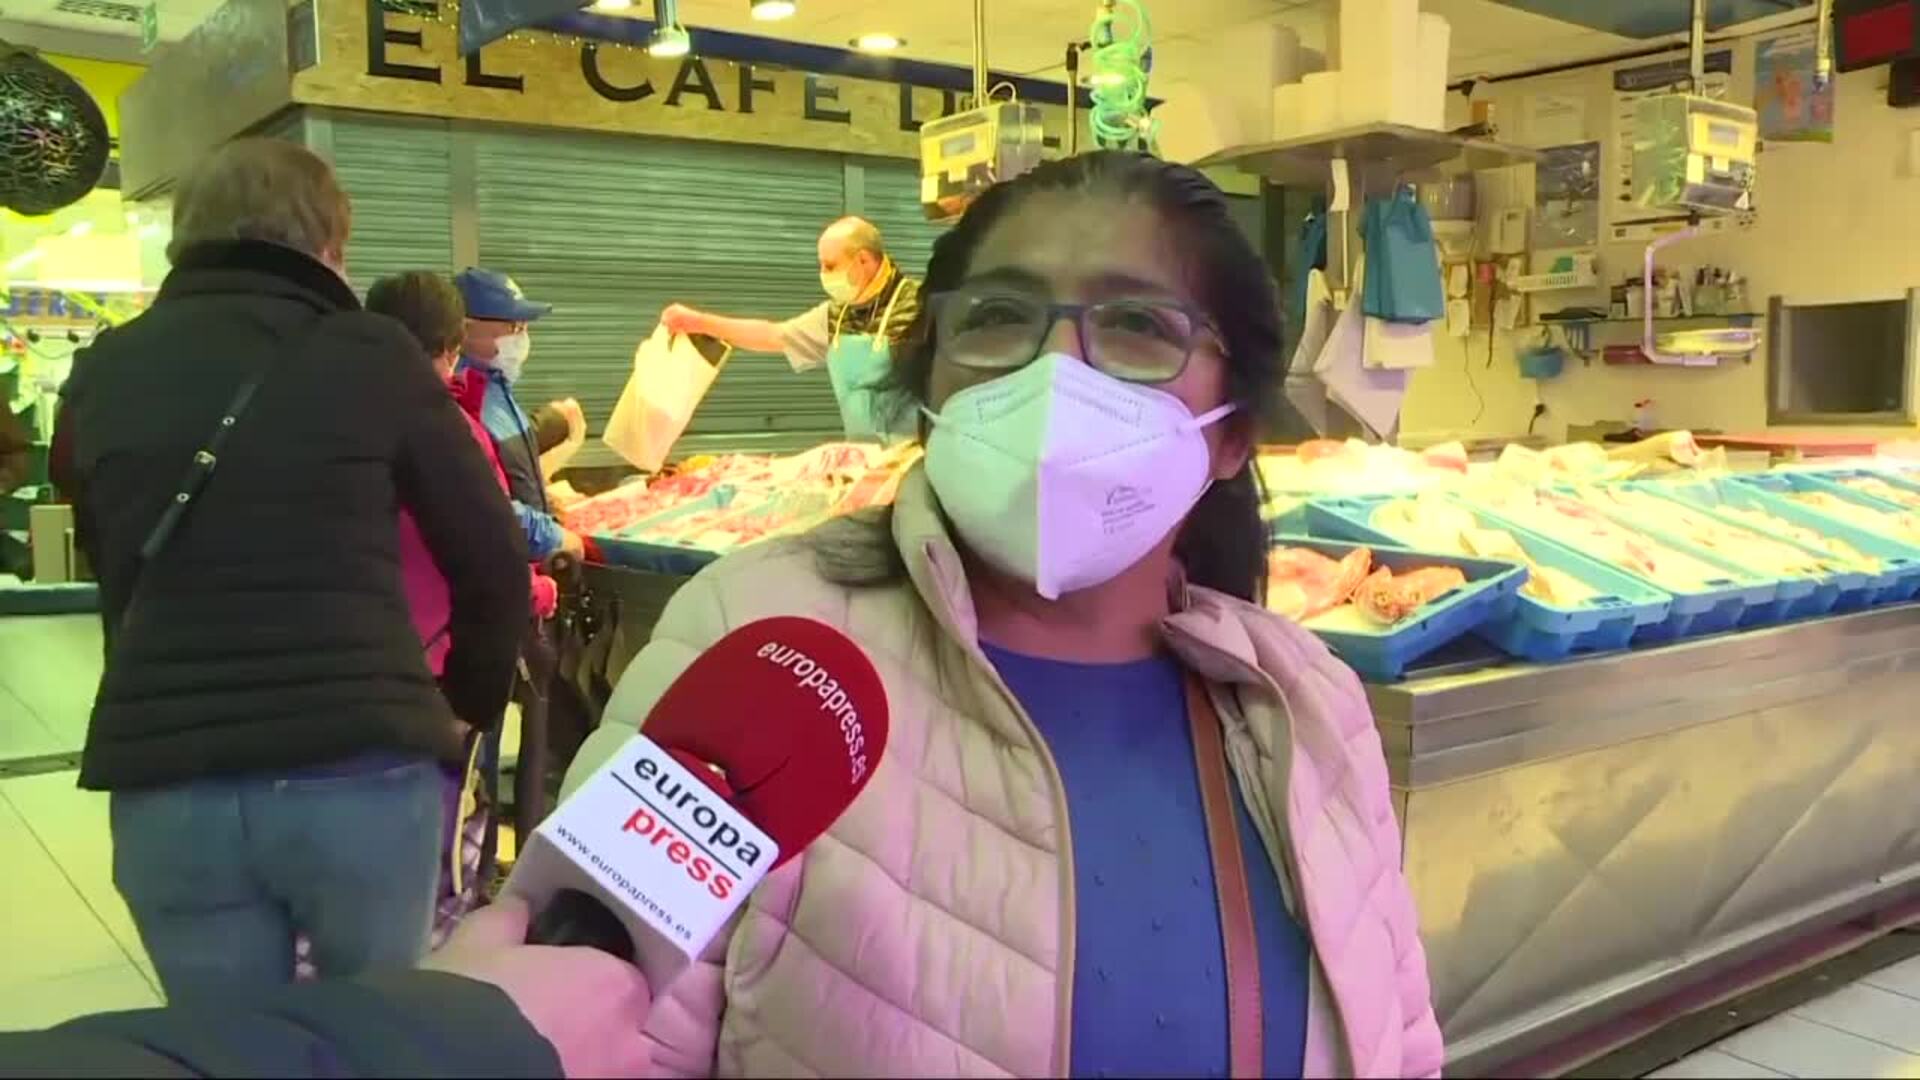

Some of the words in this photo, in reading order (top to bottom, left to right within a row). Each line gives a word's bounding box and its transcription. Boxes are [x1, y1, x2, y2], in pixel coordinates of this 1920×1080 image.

[366, 0, 525, 94] EL
[756, 641, 867, 785] europapress.es
[621, 807, 733, 901] press
[633, 757, 761, 867] europa
[556, 824, 692, 941] www.europapress.es
